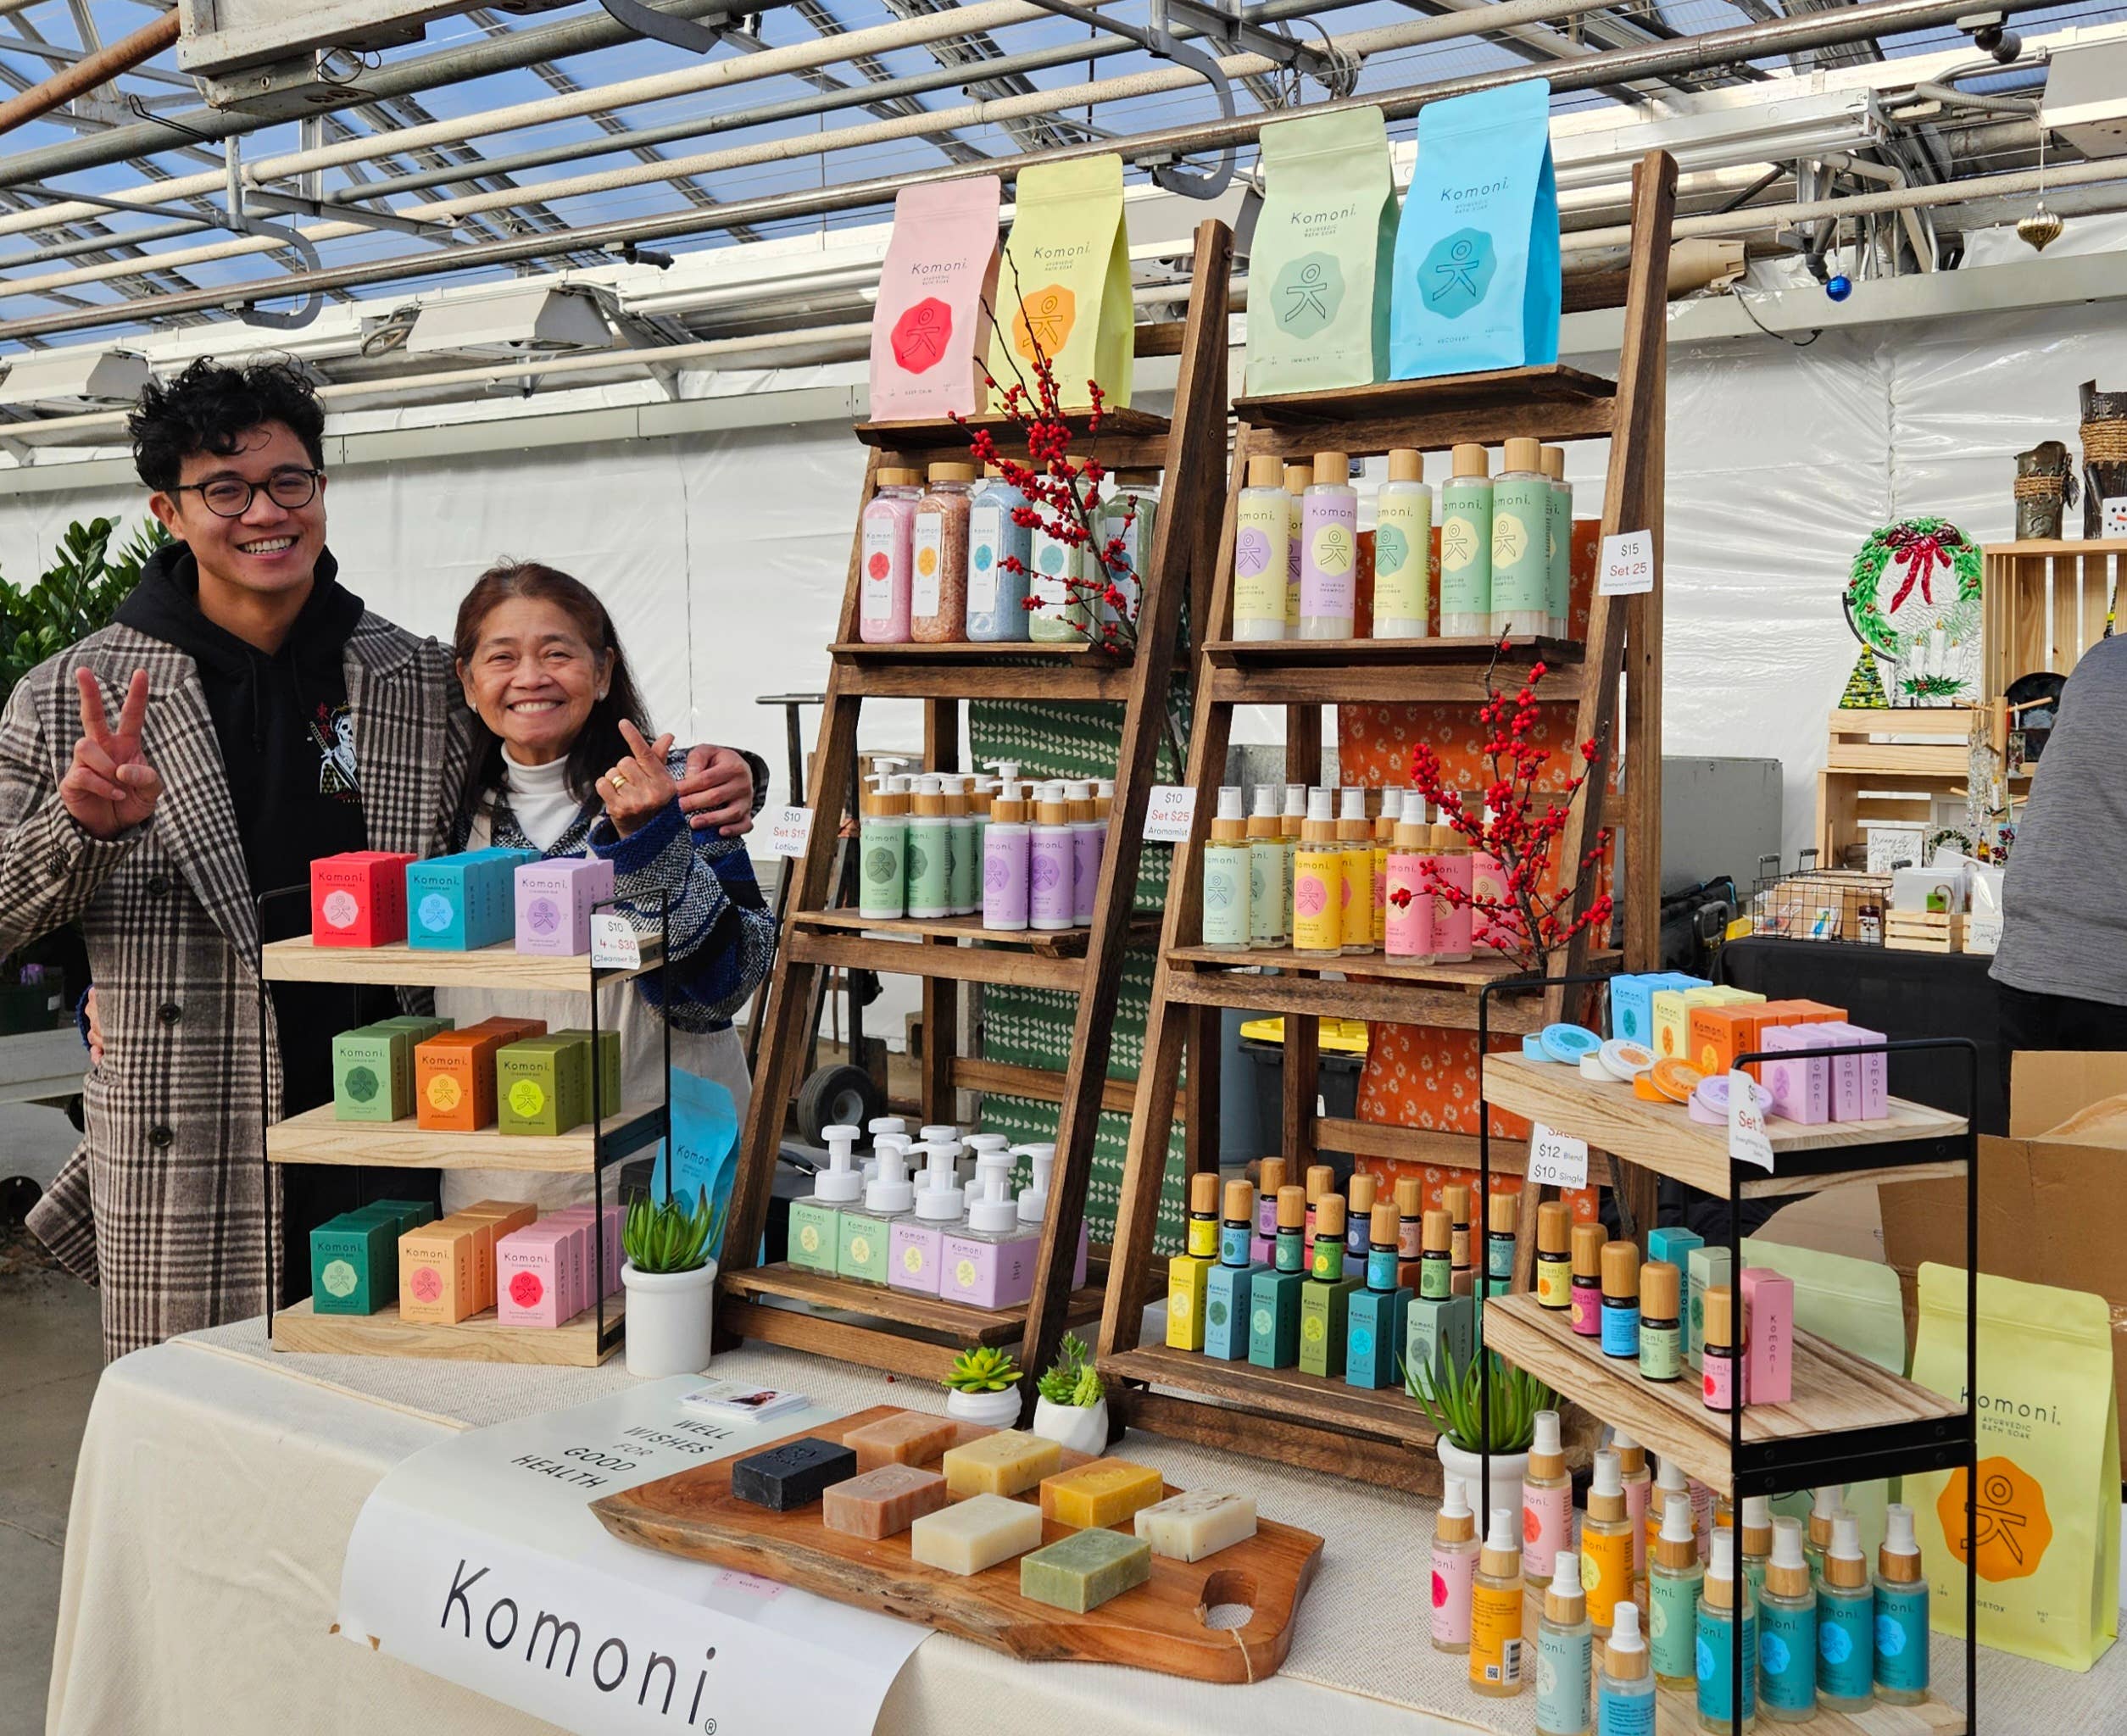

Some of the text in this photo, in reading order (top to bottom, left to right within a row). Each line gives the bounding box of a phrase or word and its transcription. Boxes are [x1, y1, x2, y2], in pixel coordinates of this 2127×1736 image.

[1621, 542, 1640, 557] $15
[1610, 562, 1647, 576] Set 25
[1165, 793, 1183, 804] $10
[784, 811, 801, 822] $10
[1151, 810, 1190, 822] Set $25
[773, 826, 806, 839] Set $15
[775, 842, 799, 852] Lotion
[608, 921, 624, 932] $10
[618, 938, 636, 950] $30
[1739, 1110, 1757, 1132] Set
[1539, 1143, 1584, 1161] $12 Blend
[1534, 1164, 1584, 1183] $10 Single
[672, 1419, 735, 1440] WELL
[1981, 1416, 2032, 1433] AYURVEDIC
[1981, 1423, 2031, 1440] BATH SOAK
[623, 1426, 715, 1455] WISHES
[612, 1443, 654, 1457] FOR
[564, 1447, 638, 1472] GOOD
[510, 1454, 609, 1488] HEALTH
[1976, 1599, 2006, 1613] DETOX
